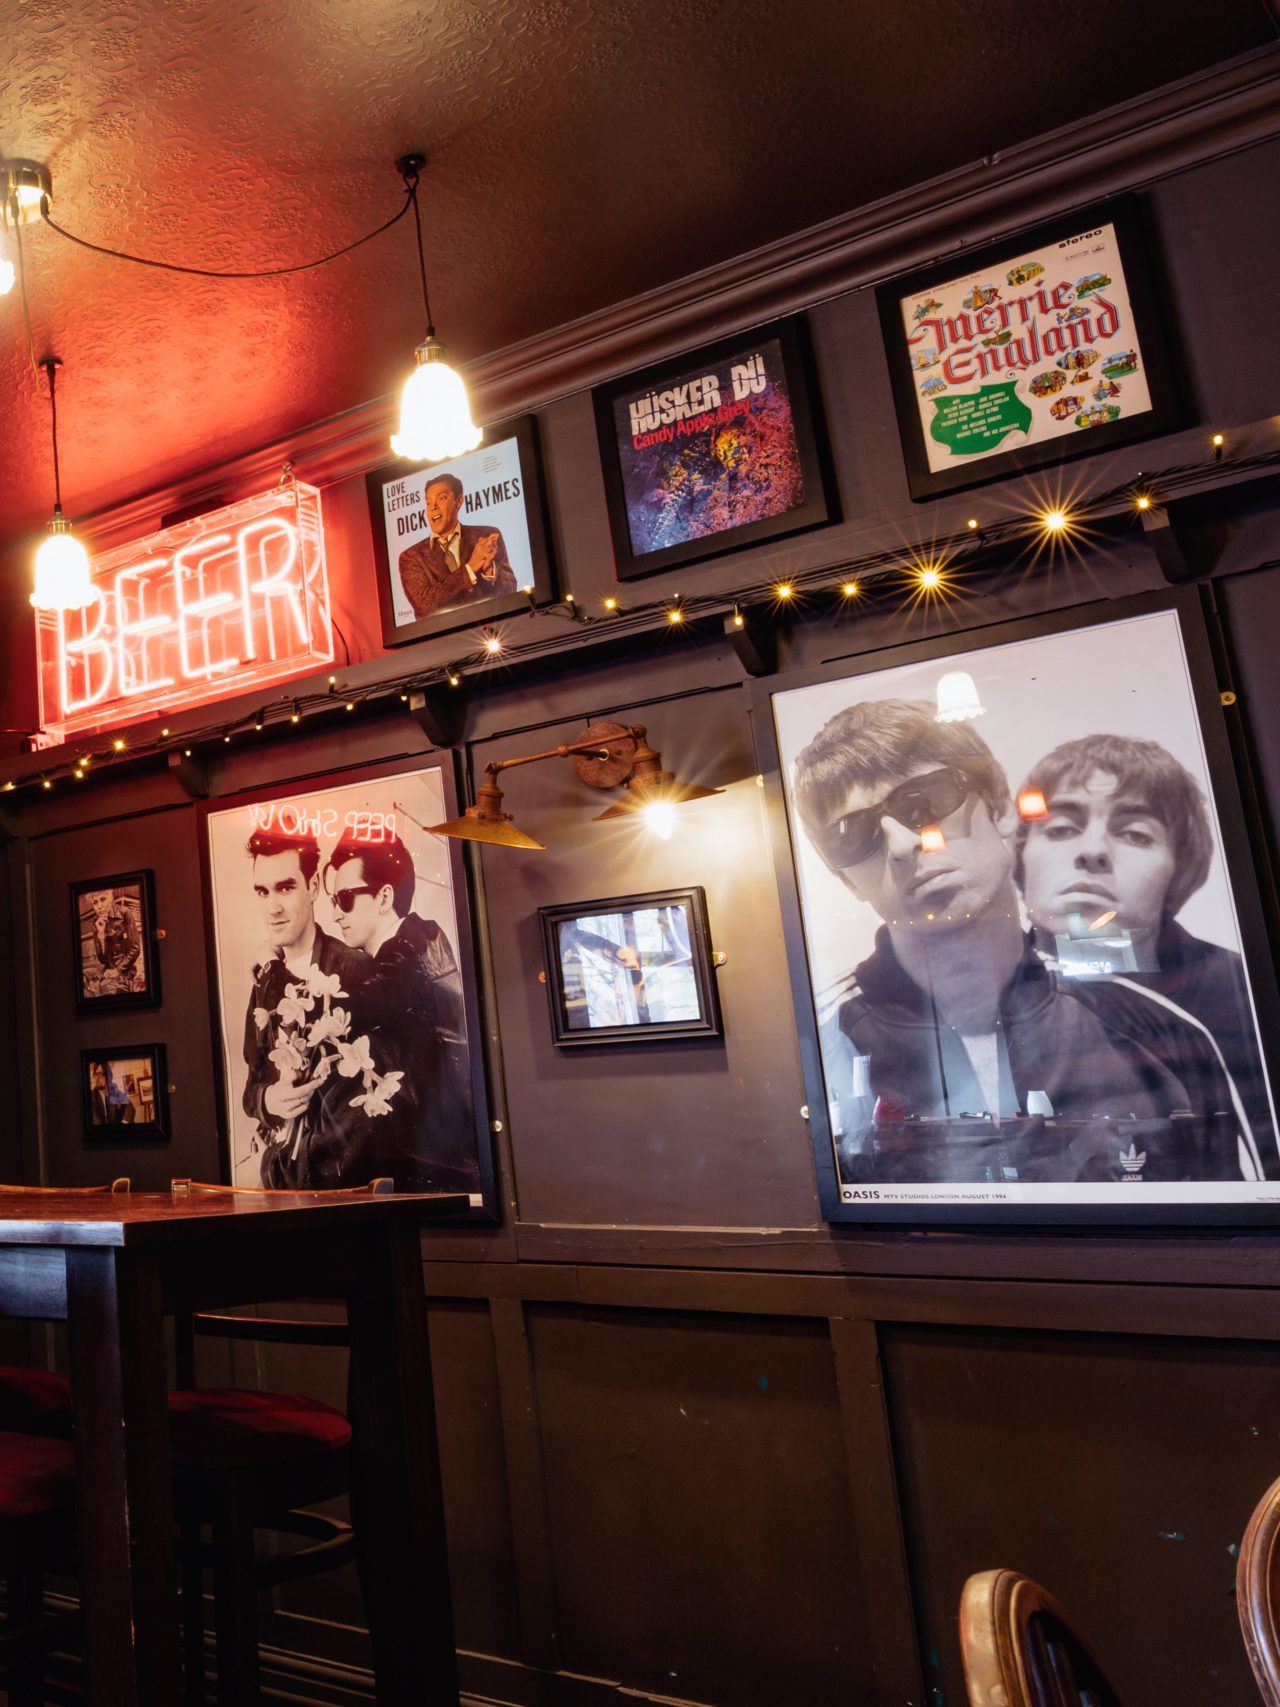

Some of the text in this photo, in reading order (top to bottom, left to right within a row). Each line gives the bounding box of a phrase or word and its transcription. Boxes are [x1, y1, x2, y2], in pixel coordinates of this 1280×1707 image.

[1058, 229, 1102, 248] stereo
[942, 291, 1121, 384] England
[629, 353, 767, 436] HÜSKER DÜ
[633, 400, 751, 451] Candy Apple Grey
[386, 482, 406, 498] LOVE
[387, 491, 420, 512] LETTERS
[396, 477, 520, 536] DICK HAYMES
[57, 517, 310, 714] BEER
[842, 1190, 880, 1200] OASIS
